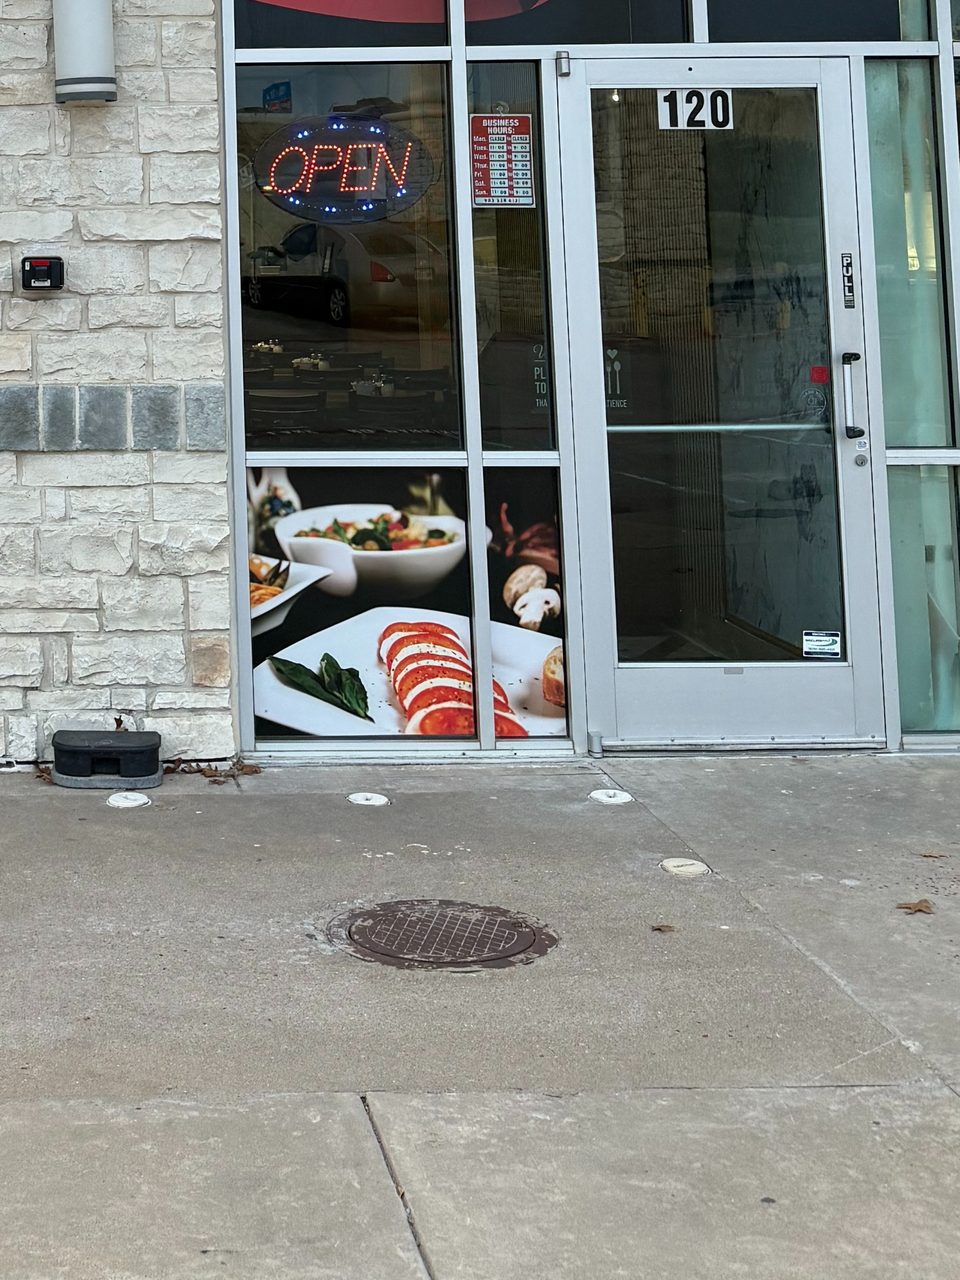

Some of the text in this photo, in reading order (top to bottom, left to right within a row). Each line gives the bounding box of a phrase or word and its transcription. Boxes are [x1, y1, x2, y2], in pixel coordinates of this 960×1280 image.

[663, 90, 730, 128] 120
[270, 142, 413, 194] OPEN
[843, 257, 853, 296] PULL
